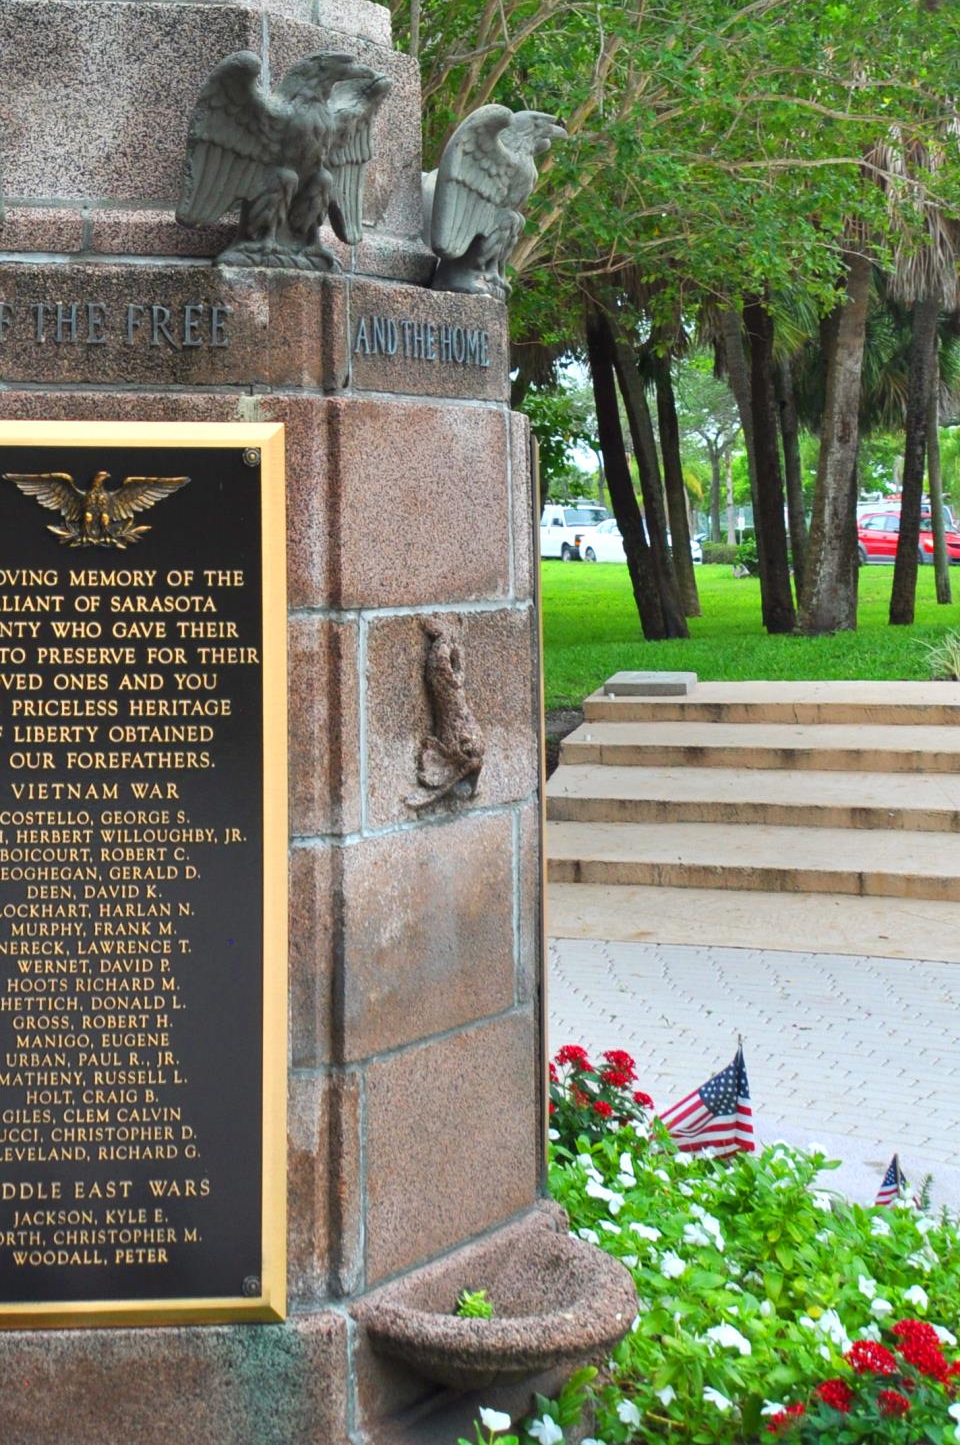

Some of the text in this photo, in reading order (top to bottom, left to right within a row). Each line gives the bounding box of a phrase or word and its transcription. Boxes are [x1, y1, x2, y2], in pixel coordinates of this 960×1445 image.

[31, 302, 107, 344] THE
[125, 303, 230, 349] FREE
[355, 315, 490, 368] AND THE HOME
[69, 570, 156, 586] MEMORY
[167, 570, 193, 586] OF
[204, 570, 243, 586] THE
[74, 595, 100, 611] OF
[110, 596, 216, 612] SARASOTA
[51, 622, 101, 637] WHO
[112, 622, 166, 638] GAVE
[176, 622, 238, 637] THEIR
[37, 647, 135, 664] PRESERVE
[147, 647, 187, 664] FOR
[197, 647, 259, 663] THEIR
[54, 673, 108, 690] ONES
[119, 674, 163, 689] AND
[174, 673, 216, 689] YOU
[12, 700, 117, 716] PRICELESS
[129, 699, 231, 715] HERITAGE
[14, 726, 98, 742] LIBERTY
[109, 726, 213, 742] OBTAINED
[9, 752, 55, 768] OUR
[67, 752, 214, 768] FOREFATHERS.
[11, 783, 178, 799] VIETNAM WAR
[0, 810, 189, 825] COSTELLO, GEORGE S.
[16, 829, 93, 843] HERBERT
[100, 828, 217, 843] WILLOUGHBY,
[224, 828, 246, 844] JR.
[0, 847, 189, 862] BOICOURT, ROBERT C.
[109, 866, 178, 879] GERALD
[185, 866, 200, 879] D.
[27, 884, 162, 899] DEEN, DAVID K.
[100, 903, 170, 916] HARLAN
[178, 903, 194, 915] N.
[11, 921, 176, 936] MURPHY, FRANK M.
[78, 940, 171, 954] LAWRENCE
[178, 939, 191, 953] T.
[17, 958, 170, 974] WERNET, DAVID P.
[7, 977, 179, 992] HOOTS RICHARD M.
[1, 995, 186, 1011] HETTICH, DONALD L.
[13, 1014, 172, 1030] GROSS, ROBERT H.
[17, 1032, 169, 1049] MANIGO, EUGENE
[6, 1051, 179, 1067] URBAN, PAUL R., JR.
[94, 1070, 166, 1085] RUSSELL
[174, 1070, 187, 1083] L.
[26, 1089, 158, 1105] HOLT, CRAIG B.
[2, 1107, 180, 1124] GILES, CLEM CALVIN
[51, 1126, 174, 1141] CHRISTOPHER
[181, 1125, 196, 1139] D.
[98, 1145, 177, 1160] RICHARD
[185, 1144, 200, 1158] G.
[75, 1181, 132, 1198] EAST
[149, 1179, 209, 1196] WARS
[13, 1208, 168, 1227] JACKSON, KYLE E.
[54, 1228, 176, 1244] CHRISTOPHER
[184, 1228, 201, 1242] M.
[13, 1248, 167, 1265] WOODALL, PETER
